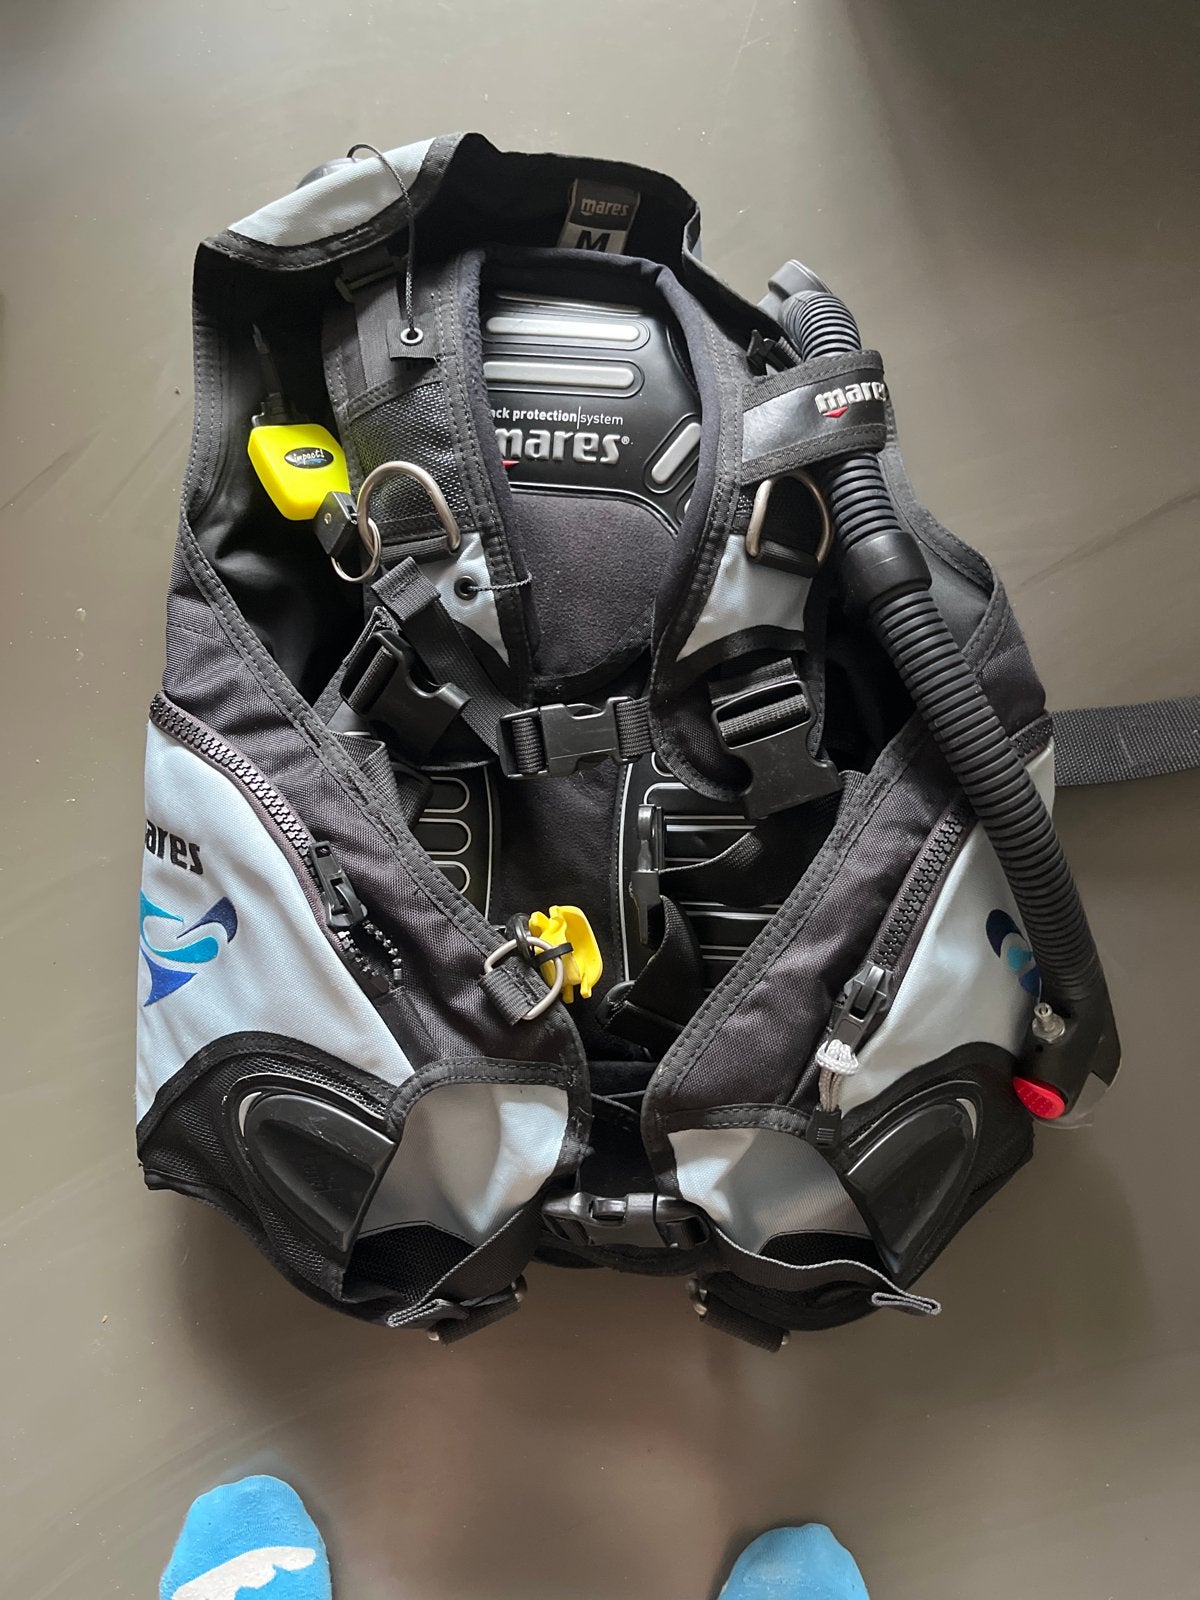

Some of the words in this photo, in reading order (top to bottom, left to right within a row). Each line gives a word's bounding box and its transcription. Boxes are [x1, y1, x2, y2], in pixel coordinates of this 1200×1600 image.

[580, 198, 630, 216] mares
[575, 230, 611, 252] M
[814, 381, 886, 413] mare
[489, 406, 510, 419] ack
[145, 818, 203, 875] ares
